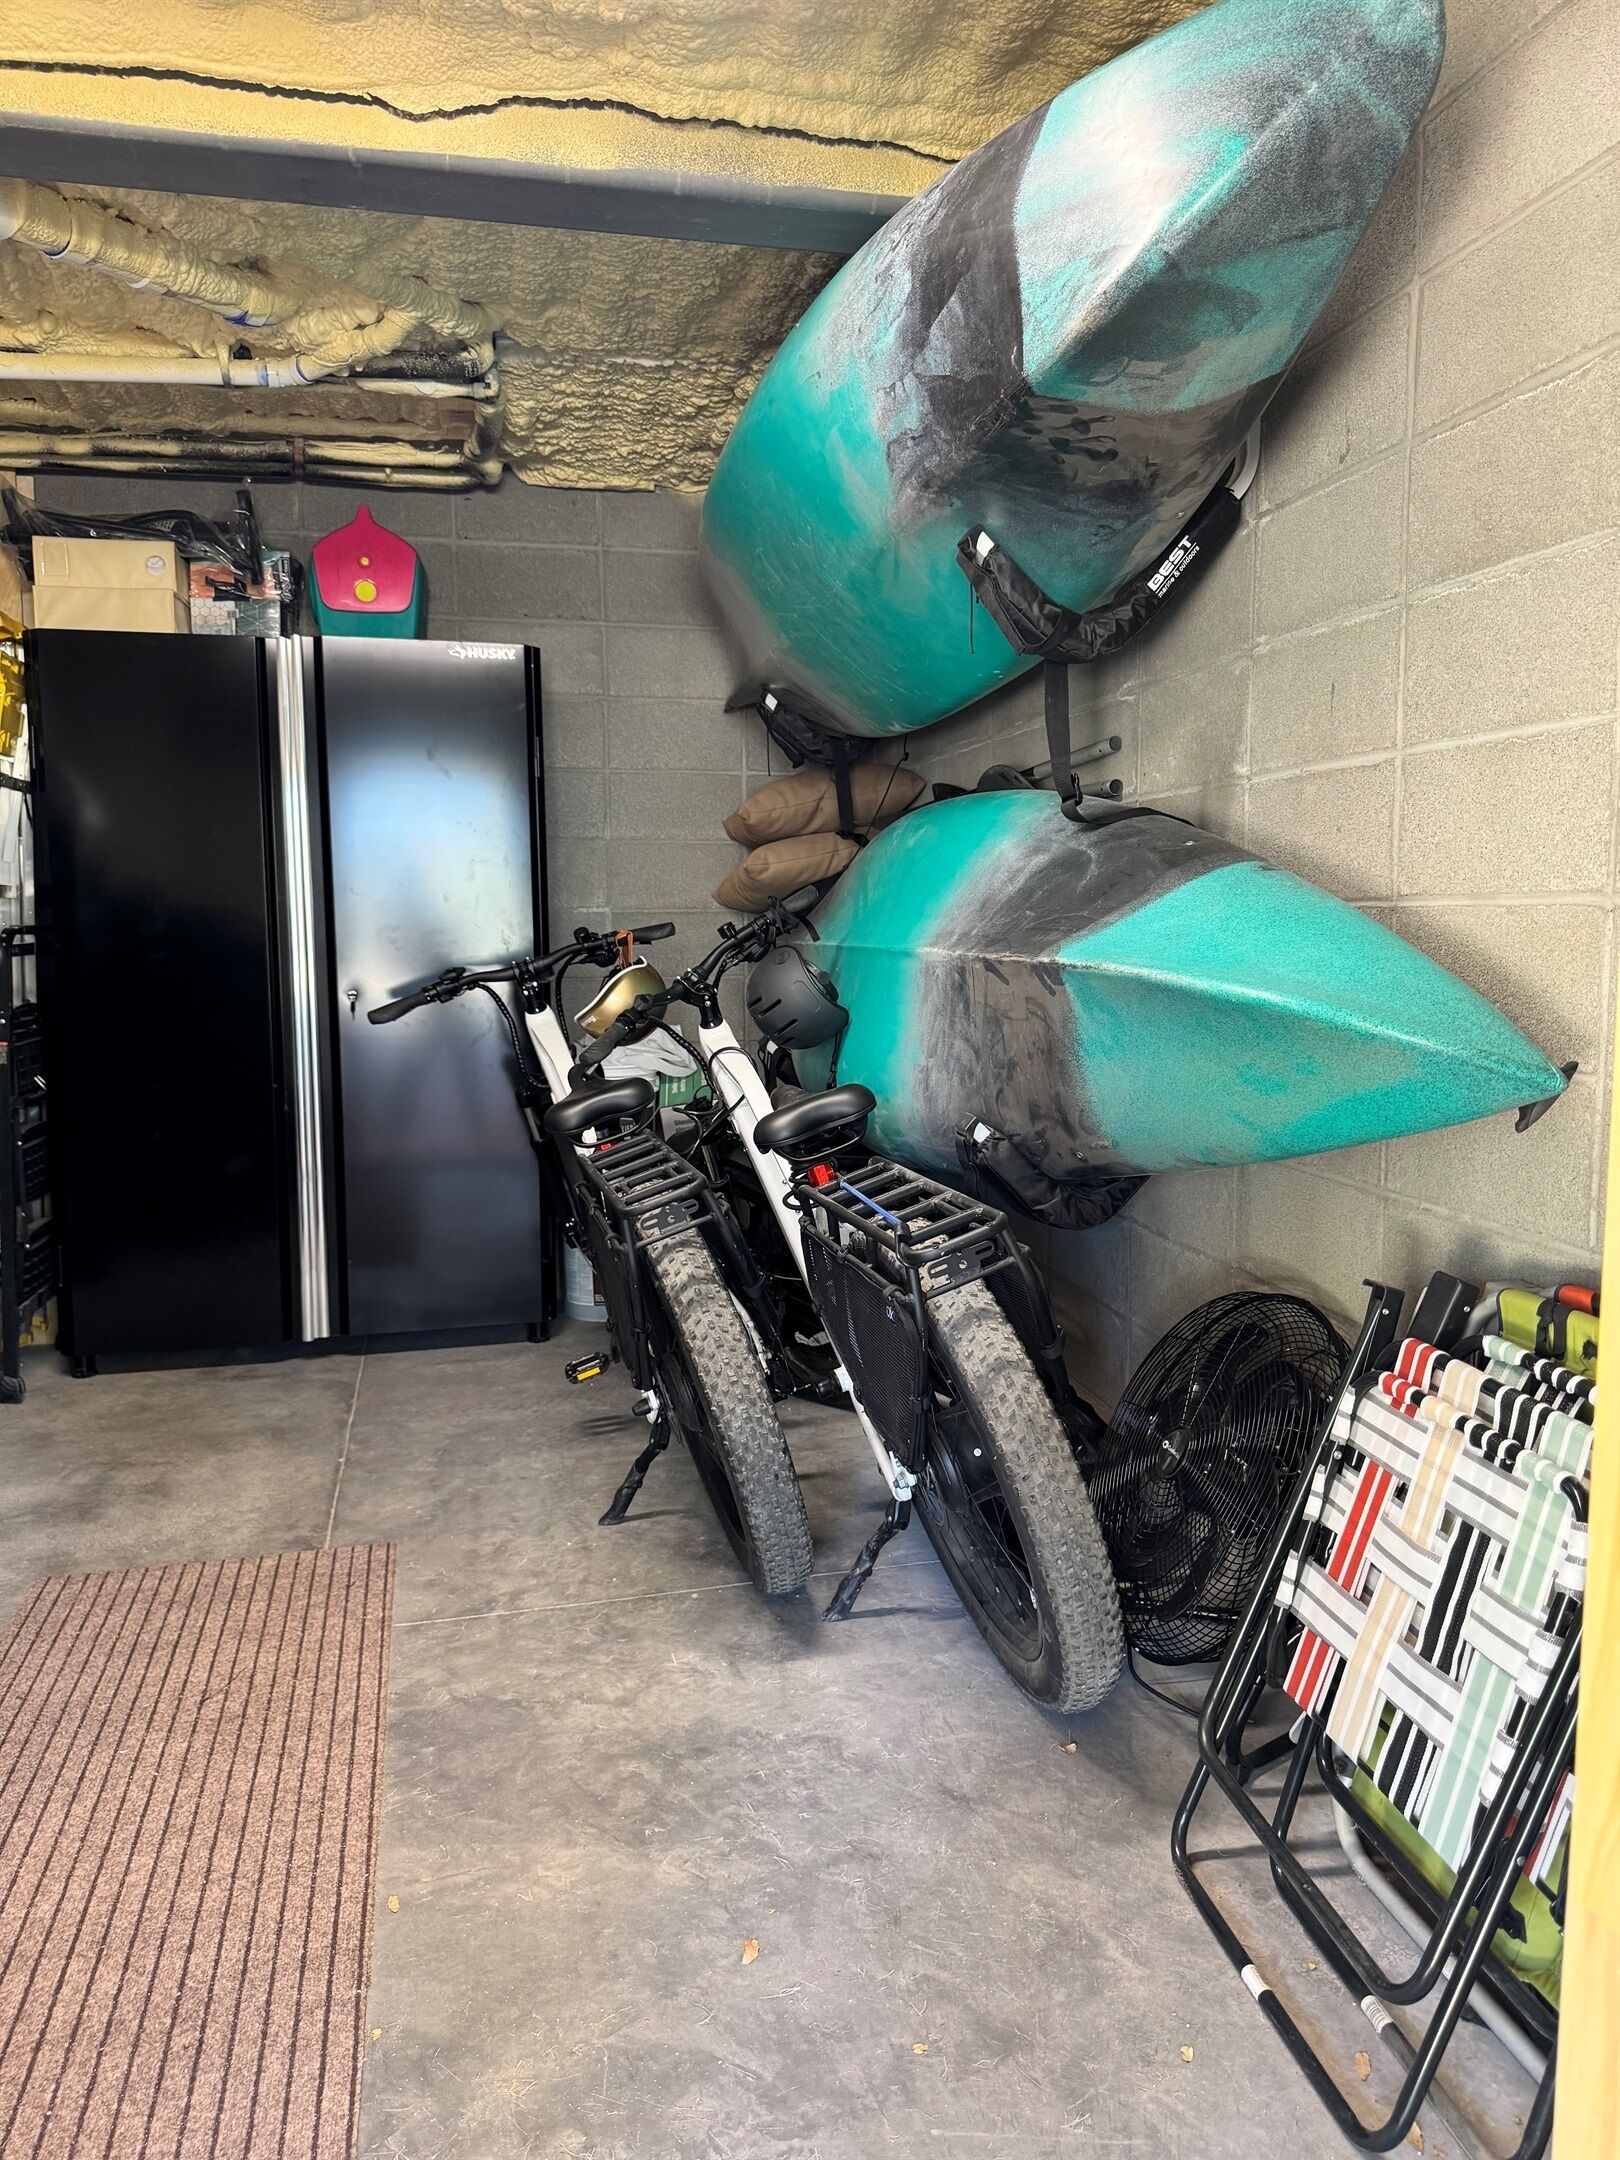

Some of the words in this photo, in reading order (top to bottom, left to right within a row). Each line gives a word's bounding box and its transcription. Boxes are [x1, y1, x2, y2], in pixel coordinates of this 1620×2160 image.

[1147, 535, 1192, 592] BEST
[1158, 577, 1175, 598] marine
[1179, 545, 1200, 572] outdoors
[466, 646, 516, 660] HUSKY
